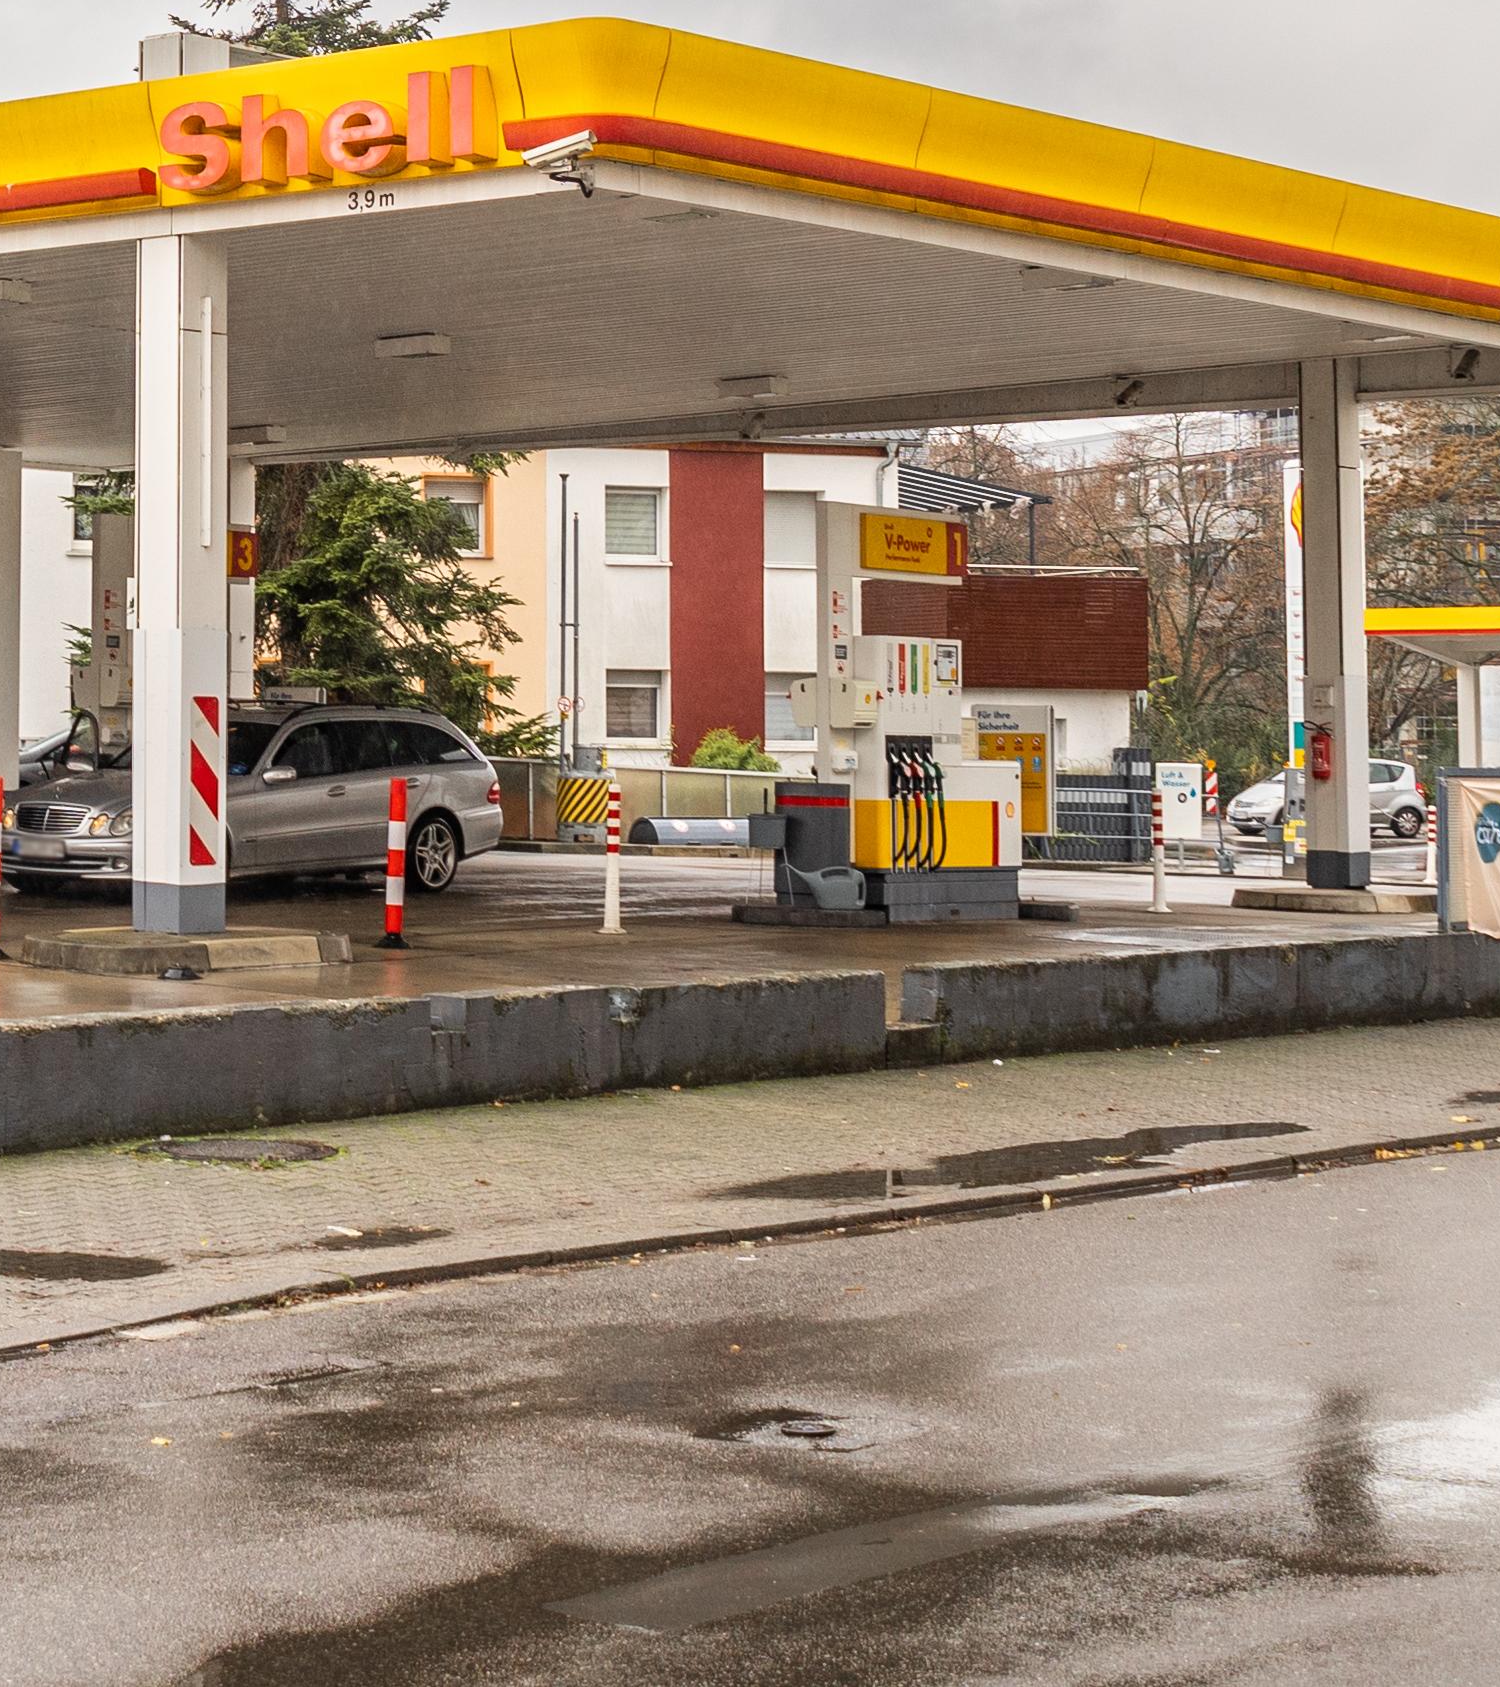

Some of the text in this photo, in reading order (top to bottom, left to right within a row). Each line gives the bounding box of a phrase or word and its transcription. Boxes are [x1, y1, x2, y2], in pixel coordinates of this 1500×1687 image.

[158, 65, 478, 192] Shell
[348, 189, 395, 212] 3,9 m
[237, 537, 253, 571] 3
[884, 533, 931, 554] V-Power
